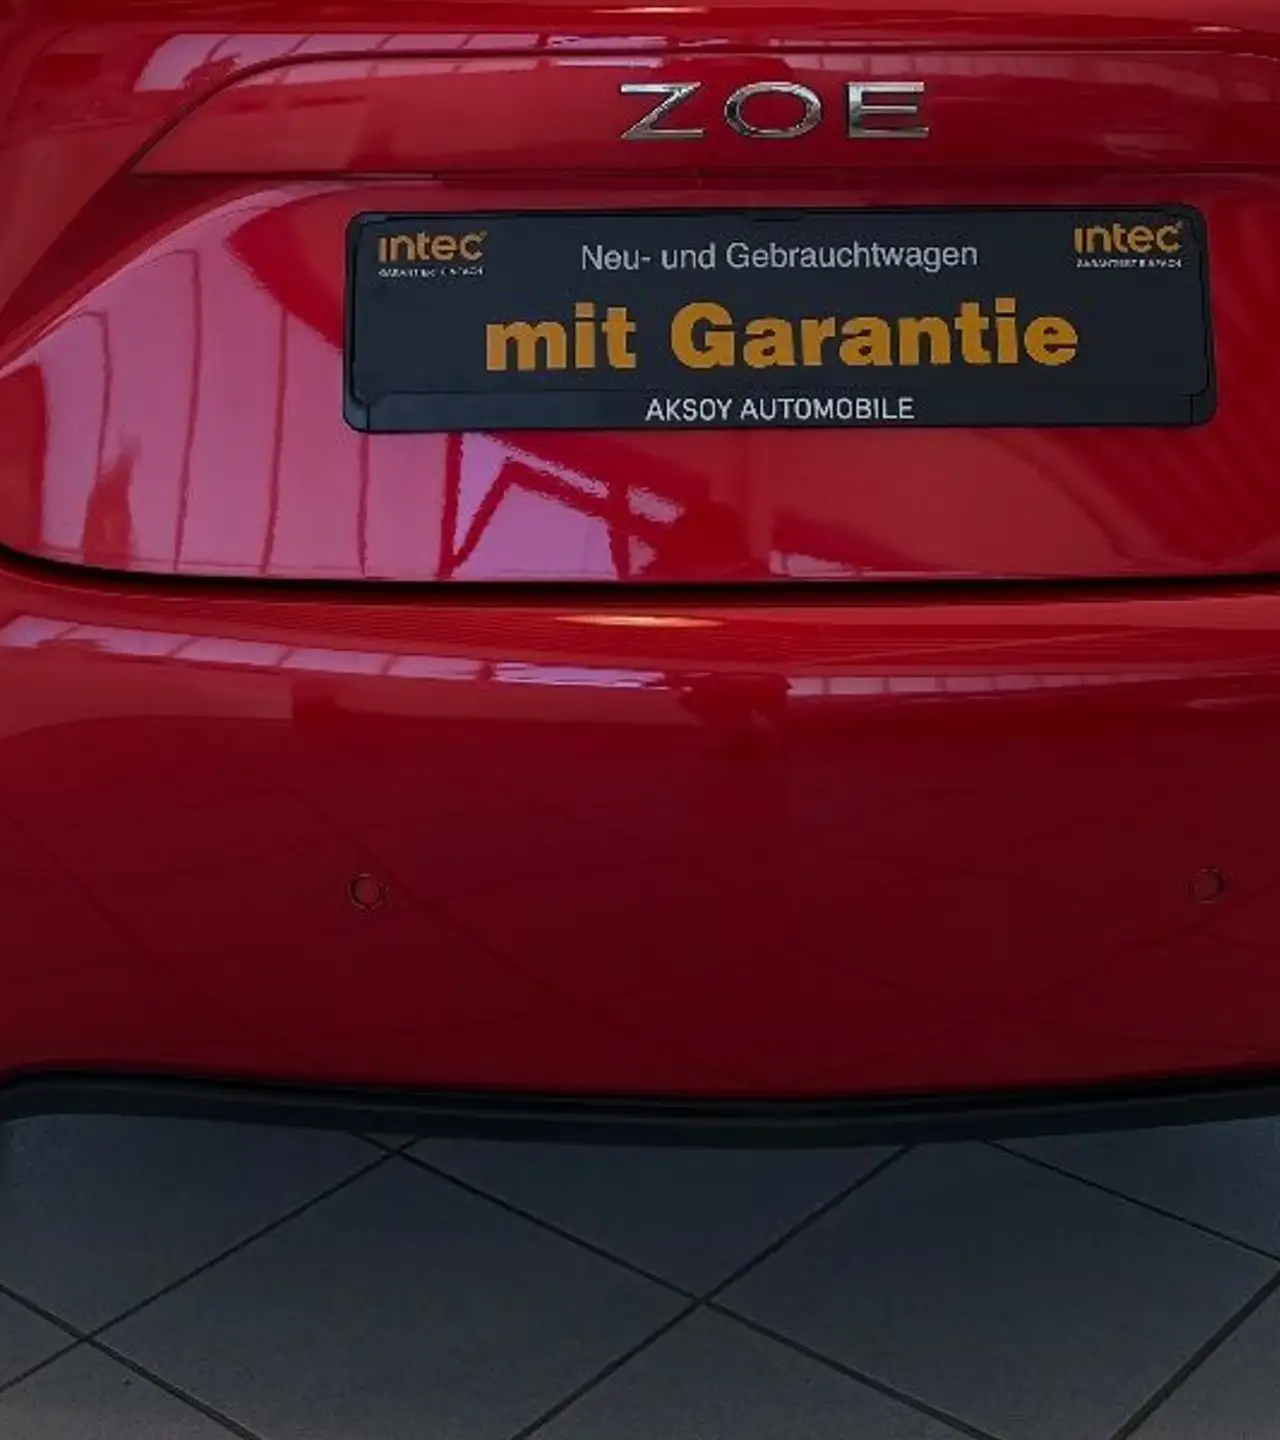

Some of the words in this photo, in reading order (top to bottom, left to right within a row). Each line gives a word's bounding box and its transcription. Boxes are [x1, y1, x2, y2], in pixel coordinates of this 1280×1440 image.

[620, 81, 930, 140] ZOE
[378, 232, 486, 262] intec
[1074, 222, 1182, 253] intec
[582, 244, 651, 271] Neu-
[661, 242, 716, 270] und
[726, 240, 978, 273] Gebrauchtwagen
[486, 302, 636, 371] mit
[671, 297, 1078, 369] Garantie
[644, 398, 733, 422] AKSOY
[740, 397, 915, 422] AUTOMOBILE
